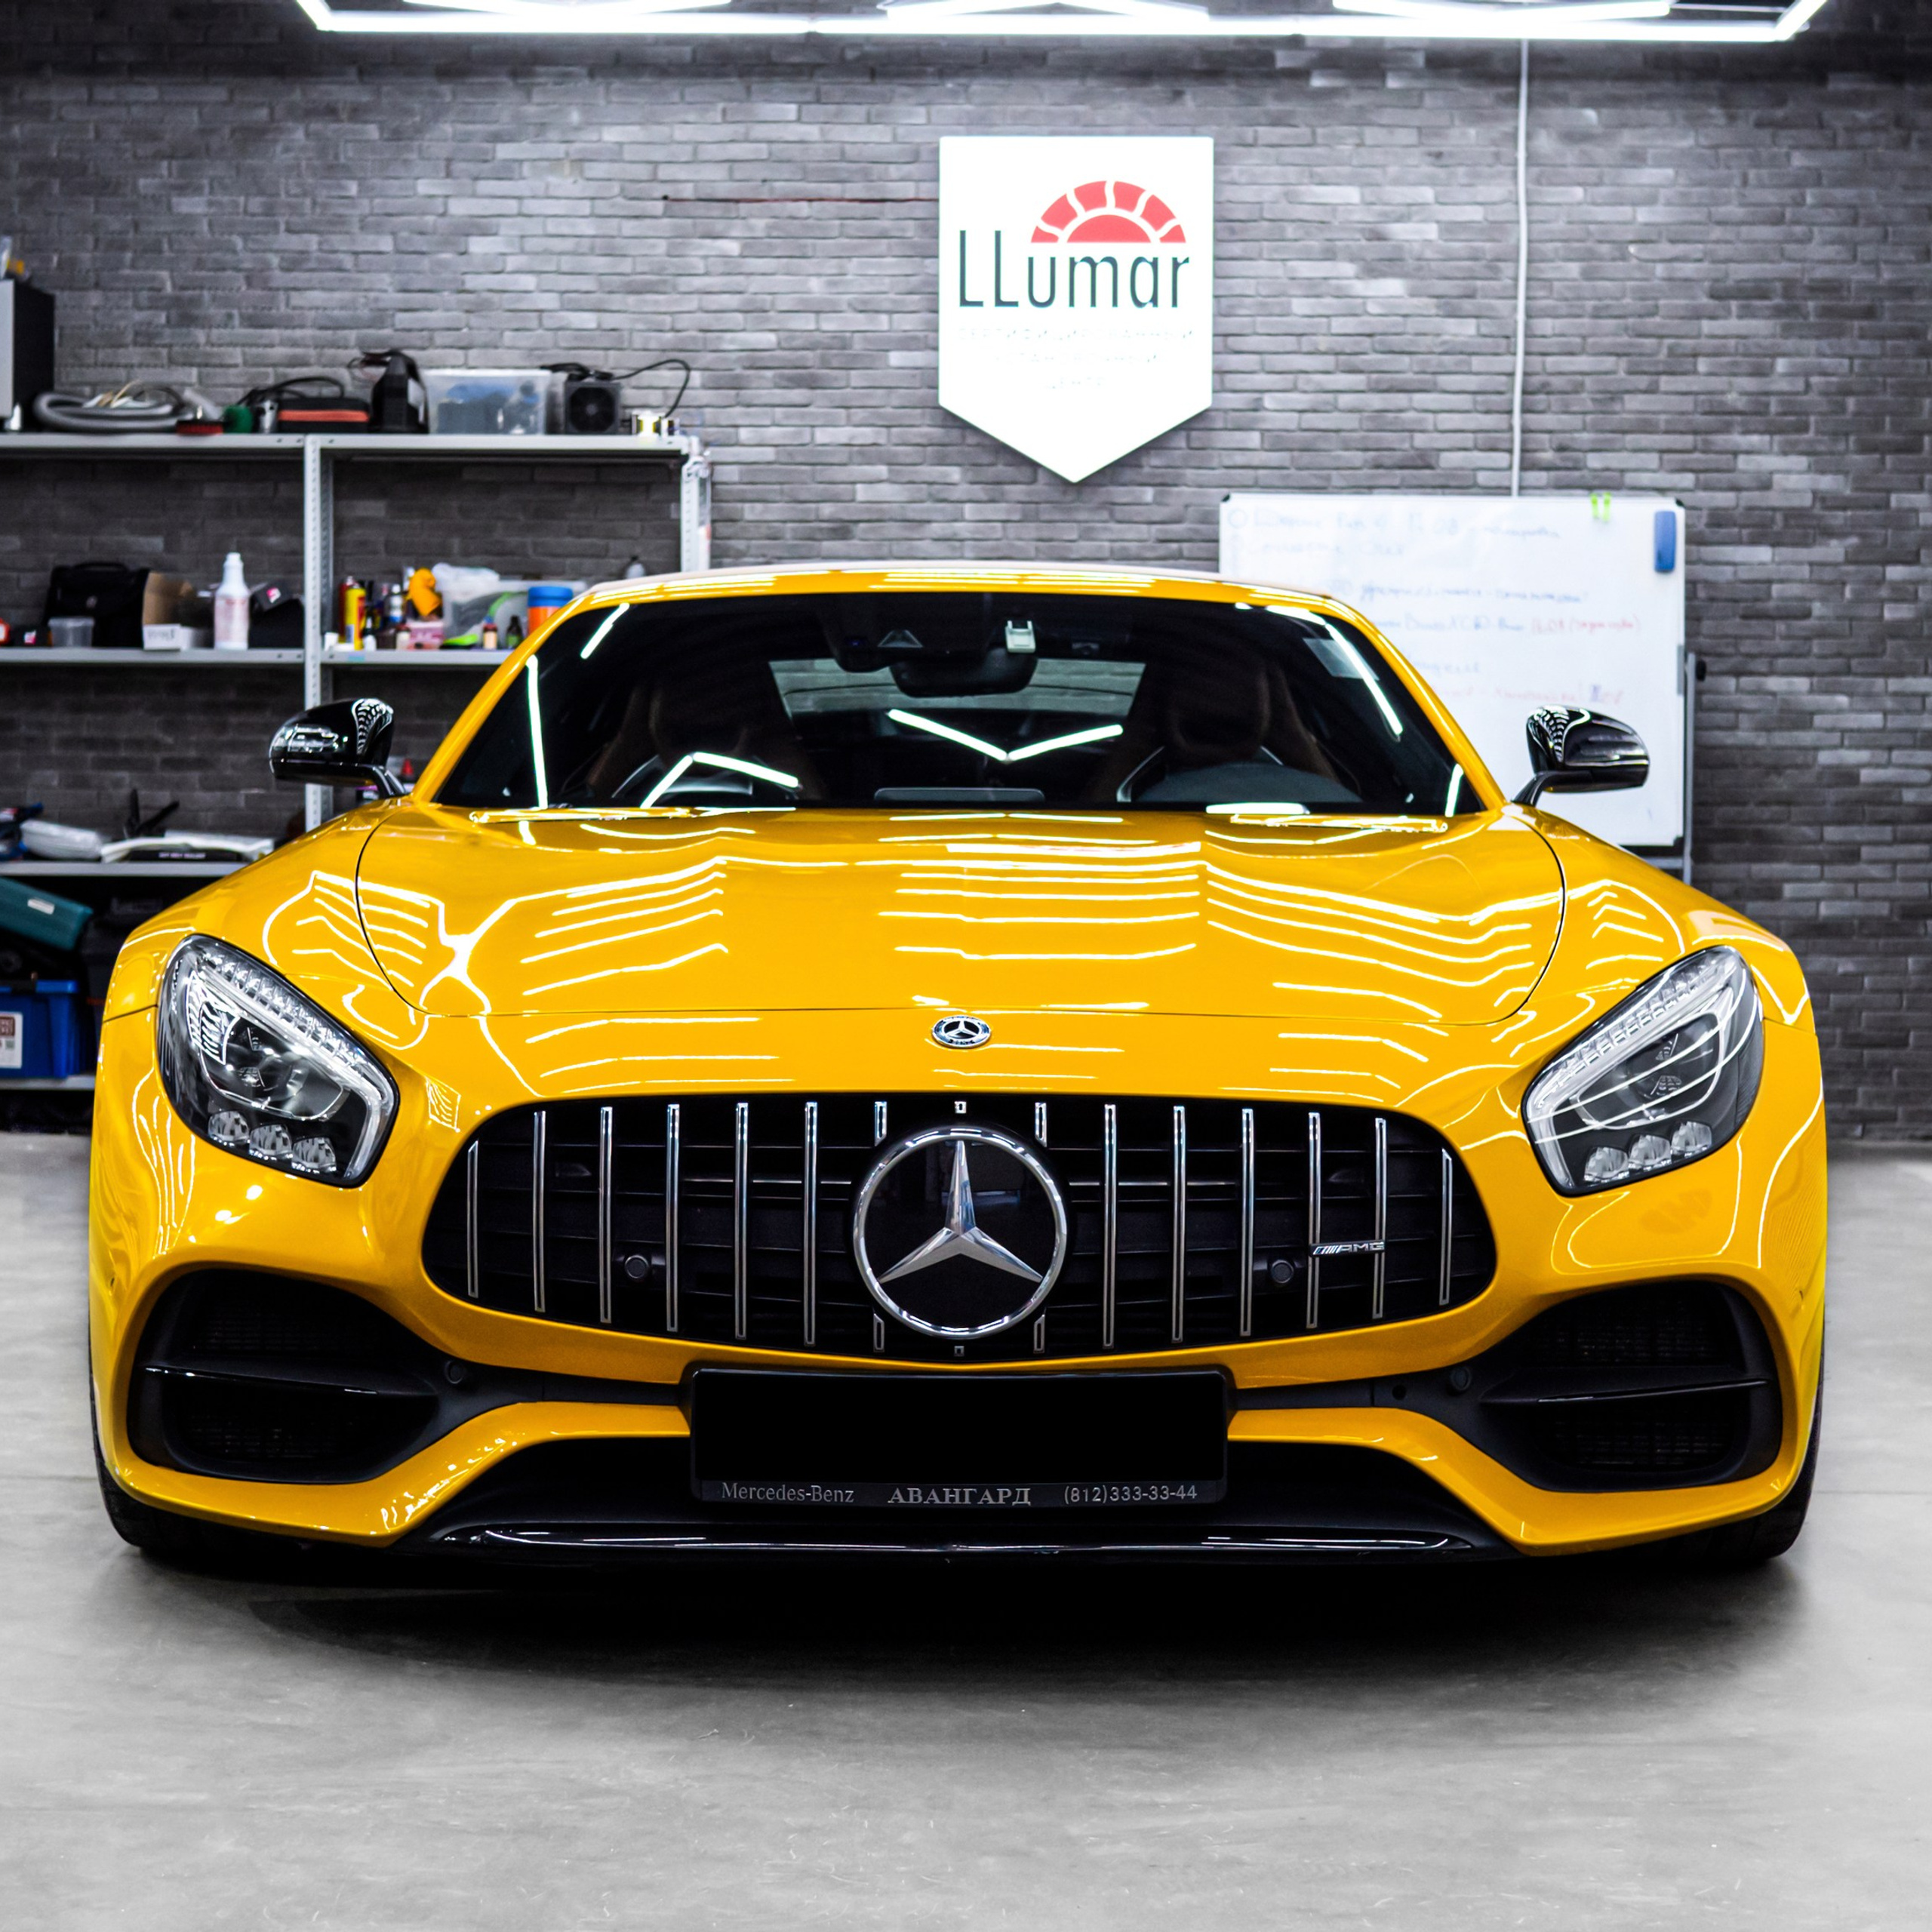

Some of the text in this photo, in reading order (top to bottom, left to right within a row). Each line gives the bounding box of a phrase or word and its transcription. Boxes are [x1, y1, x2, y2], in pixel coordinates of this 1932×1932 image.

[958, 229, 1191, 309] LLumar
[1334, 1241, 1386, 1254] AMG
[721, 1481, 855, 1503] Mercedes-Benz
[887, 1487, 1032, 1506] АВАНГАРД
[1063, 1484, 1198, 1505] (812)333-33-44
